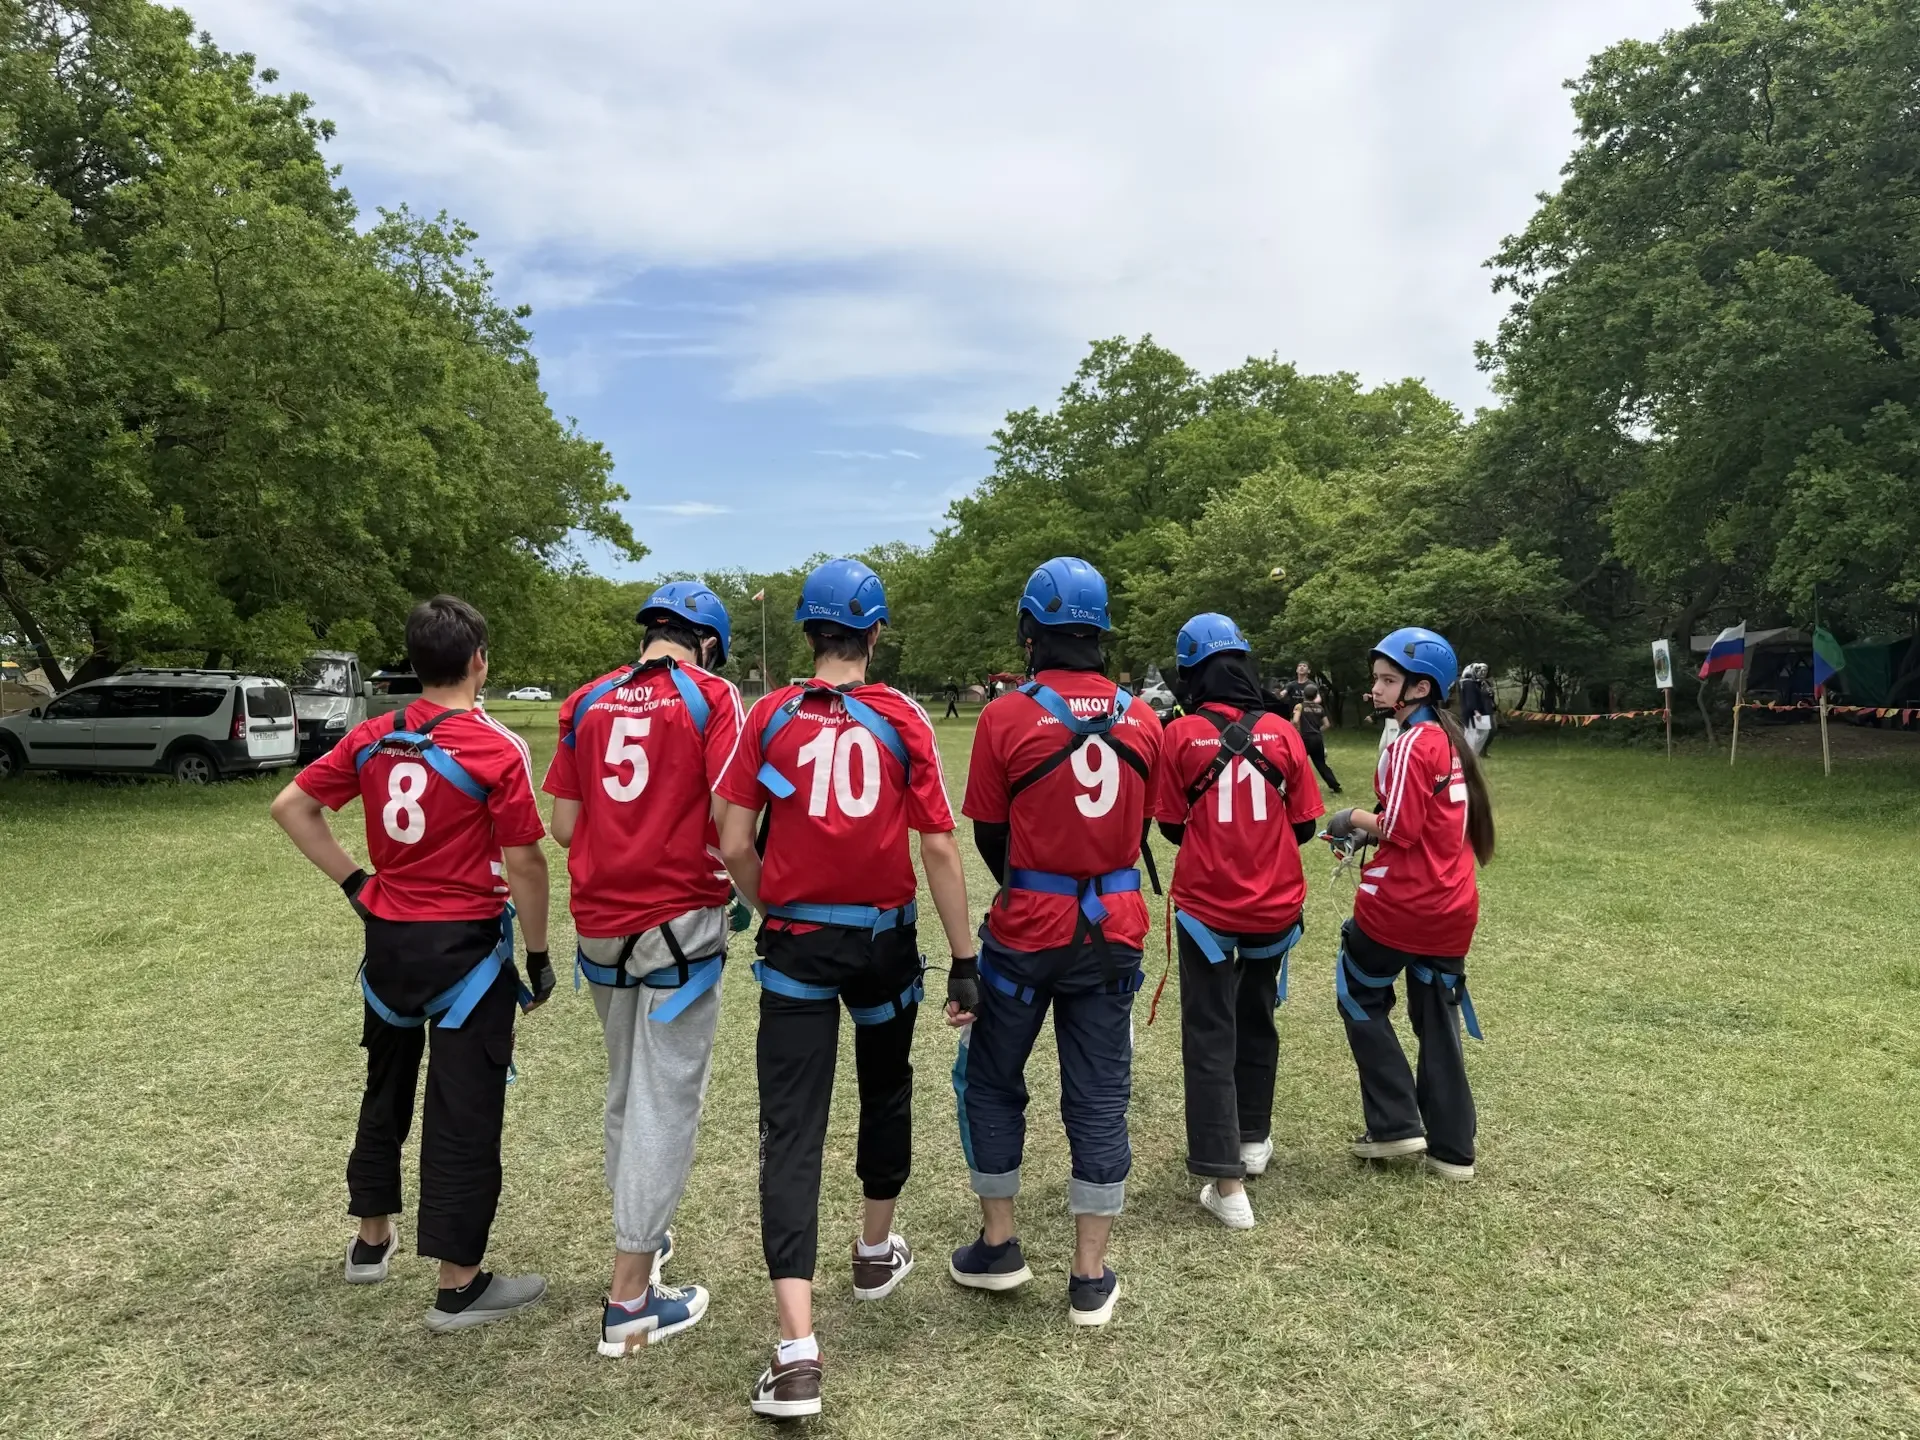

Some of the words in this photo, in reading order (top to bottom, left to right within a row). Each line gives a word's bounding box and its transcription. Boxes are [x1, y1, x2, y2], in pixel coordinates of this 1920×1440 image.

[1069, 698, 1109, 712] МКОУ
[602, 716, 651, 803] 5
[797, 726, 881, 818] 10
[1070, 733, 1120, 818] 9
[1218, 745, 1268, 823] 11
[382, 762, 428, 845] 8
